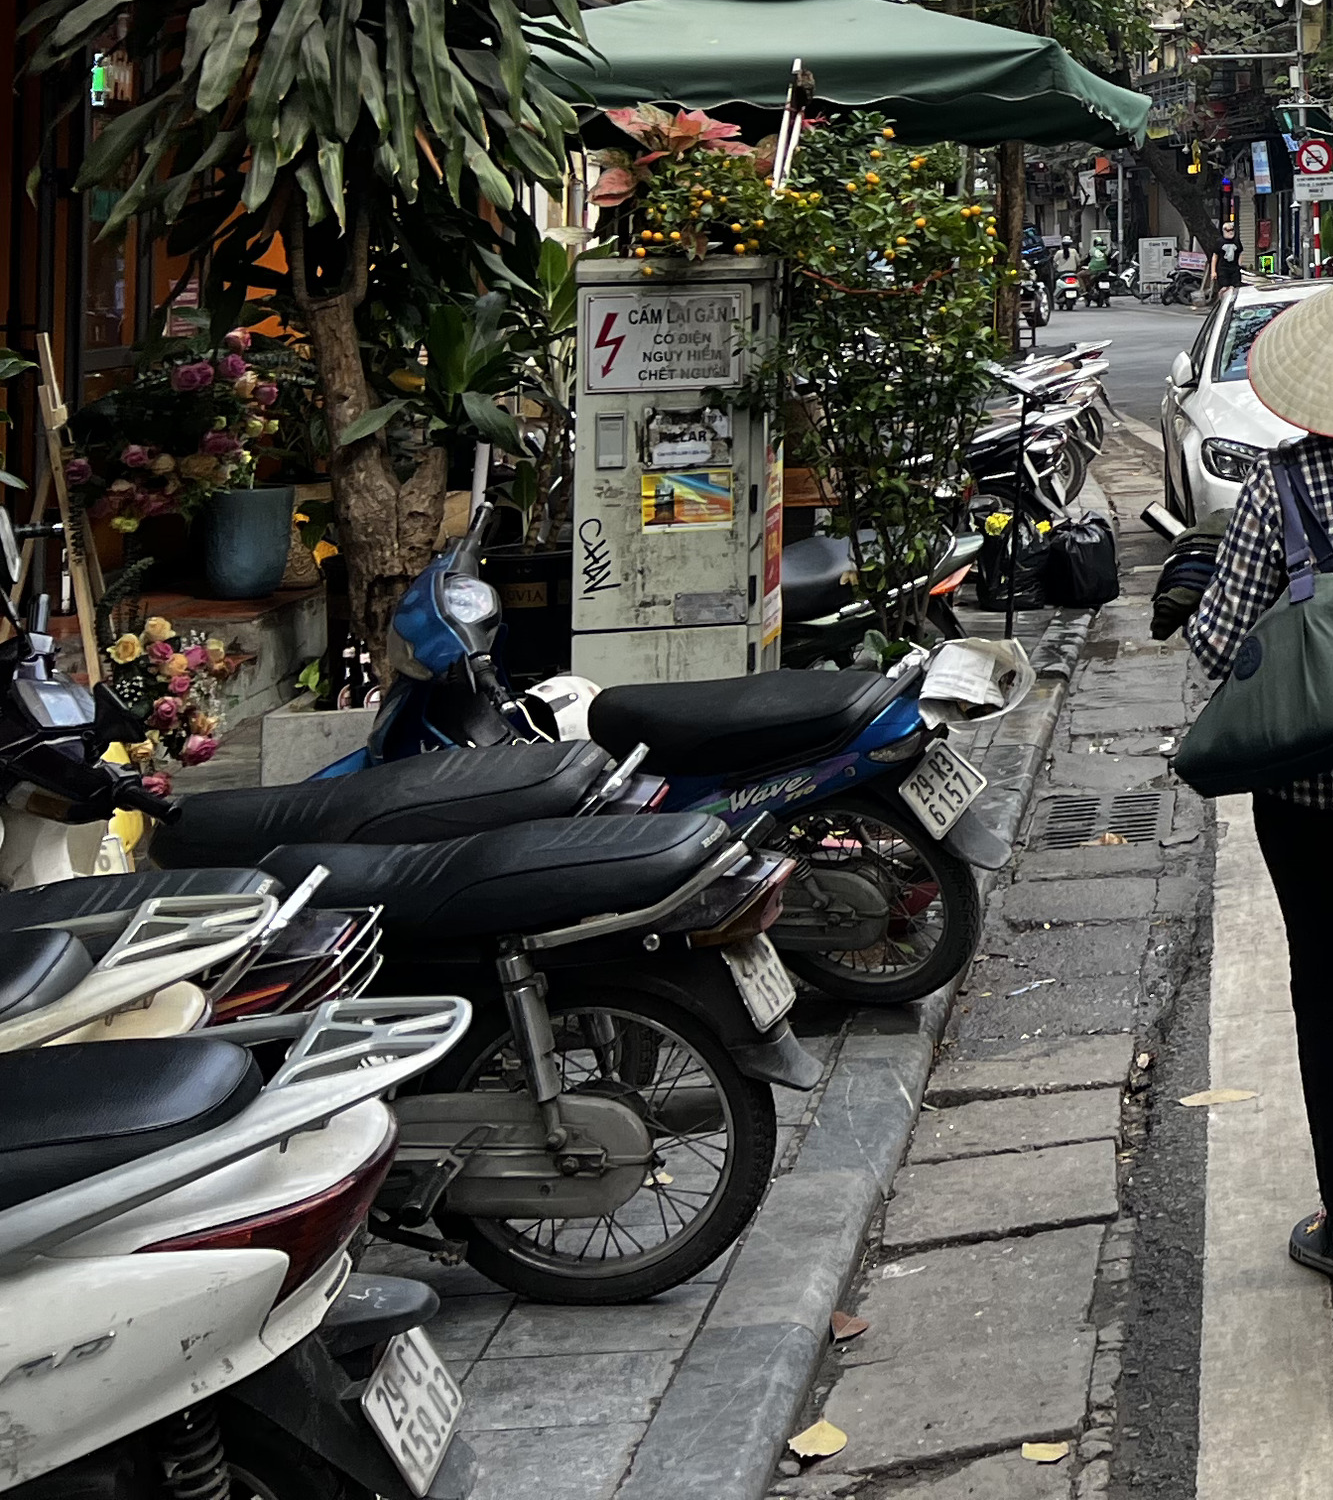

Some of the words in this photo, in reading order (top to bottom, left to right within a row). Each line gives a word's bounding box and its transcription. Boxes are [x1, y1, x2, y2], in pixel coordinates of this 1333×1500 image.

[628, 303, 662, 326] CẤM
[666, 307, 691, 329] LẠI
[642, 350, 682, 364] NGUY
[688, 344, 722, 362] HIỂM
[653, 330, 674, 345] CÓ
[677, 330, 712, 346] ĐIỆN
[638, 364, 676, 381] CHẾT
[729, 774, 813, 814] Wave
[910, 750, 954, 806] 29-R3
[928, 770, 971, 827] 6157
[376, 1331, 429, 1434] 29-C1
[400, 1365, 459, 1479] 159.03
